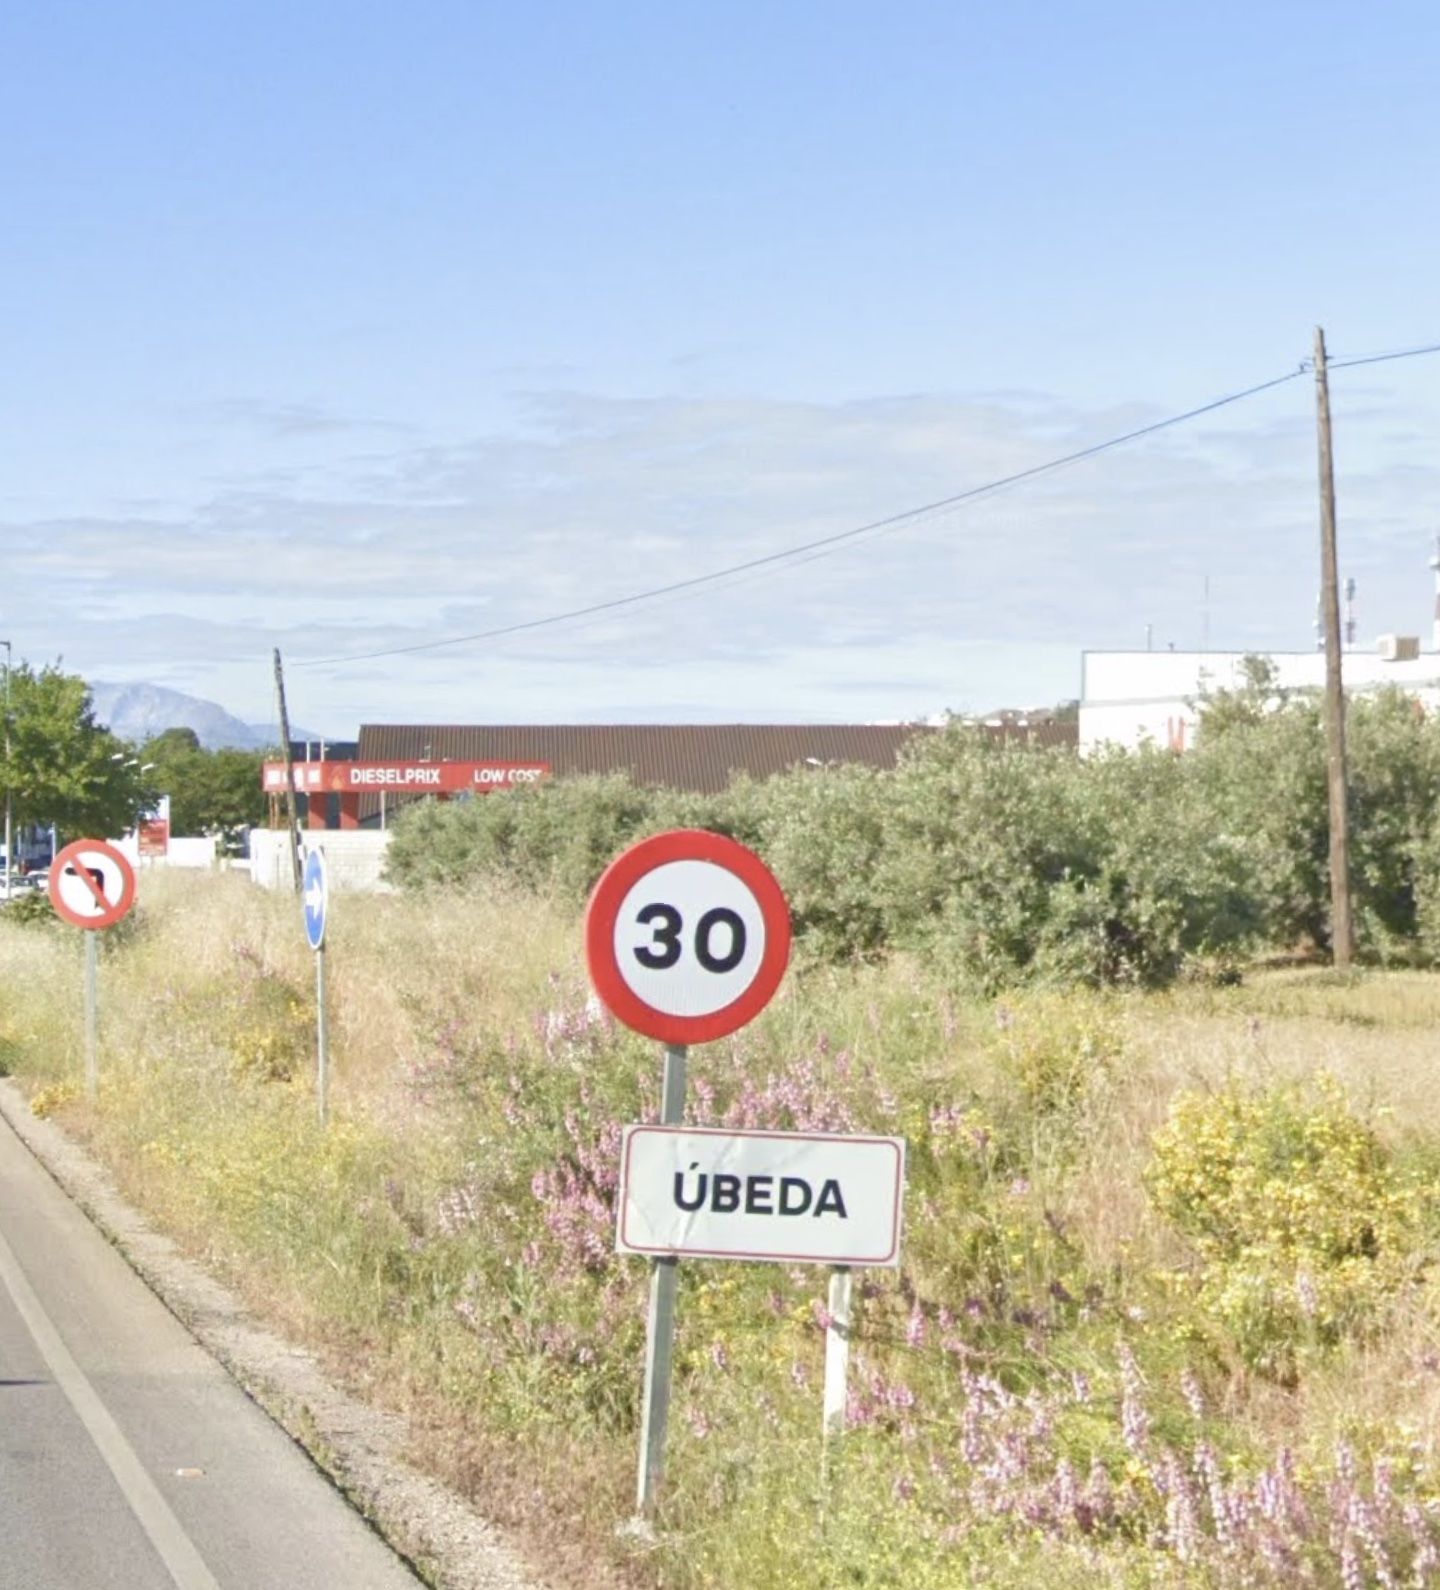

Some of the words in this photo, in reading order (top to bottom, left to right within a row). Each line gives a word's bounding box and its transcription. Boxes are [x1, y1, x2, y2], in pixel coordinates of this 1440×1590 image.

[350, 768, 441, 785] DIESELPRIX
[474, 768, 506, 784] LOW
[633, 902, 747, 974] 30
[673, 1162, 848, 1219] ÚBEDA
